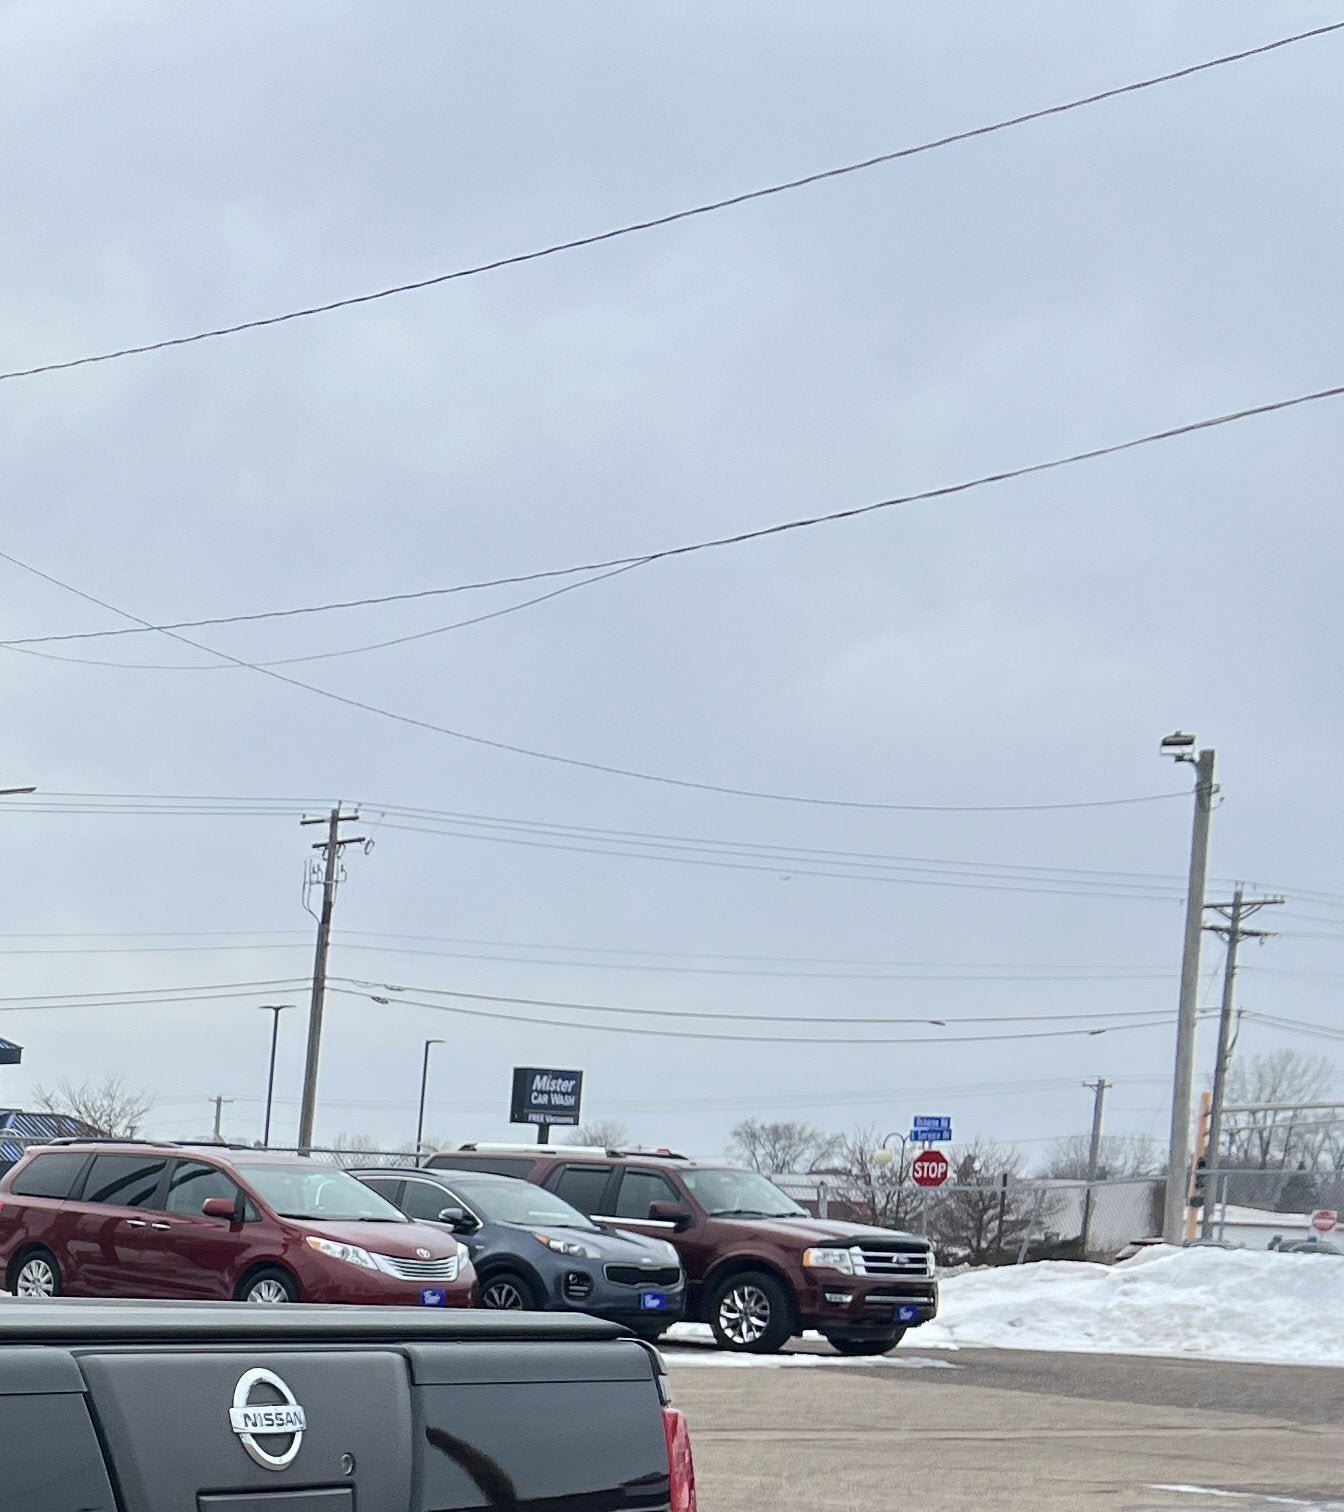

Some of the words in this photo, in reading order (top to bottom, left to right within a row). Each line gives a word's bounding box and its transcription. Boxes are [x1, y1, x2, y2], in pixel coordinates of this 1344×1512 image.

[532, 1074, 576, 1093] Mister
[531, 1091, 549, 1105] CAR
[550, 1092, 575, 1107] WASH
[914, 1161, 947, 1179] STOP
[243, 1411, 304, 1428] NISSAN
